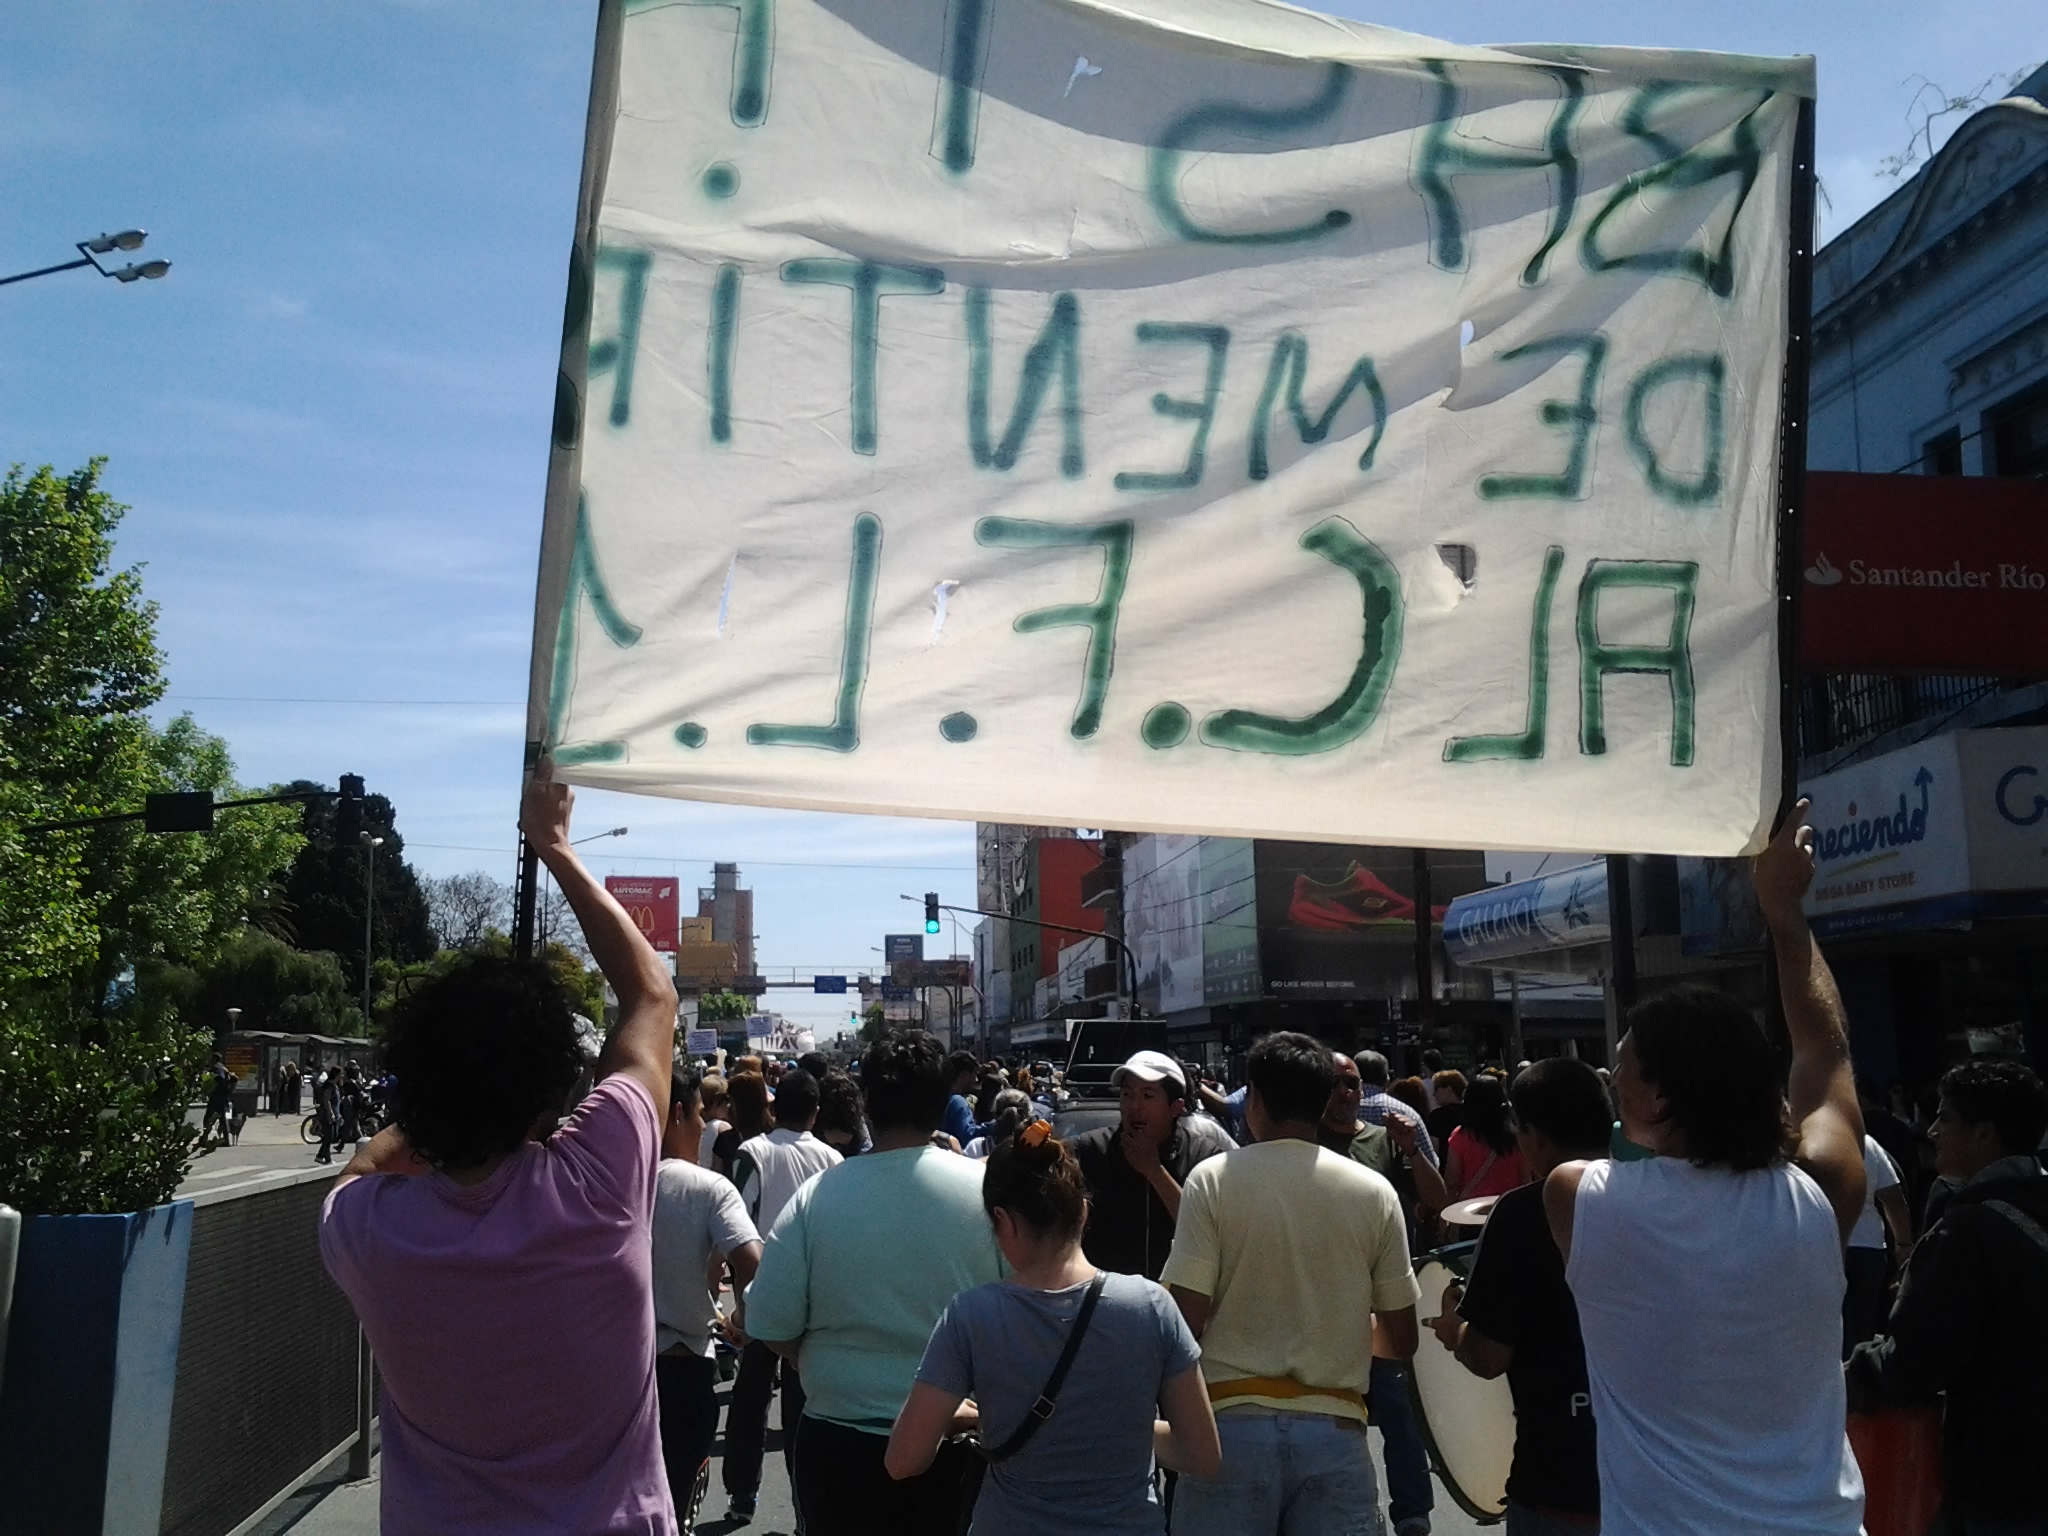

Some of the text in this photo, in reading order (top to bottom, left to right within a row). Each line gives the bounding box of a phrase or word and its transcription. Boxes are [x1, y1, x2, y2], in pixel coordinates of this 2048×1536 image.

[1849, 559, 2046, 590] Santander Río
[1803, 770, 1932, 861] reciendo
[1846, 879, 1874, 897] BABY
[1878, 871, 1916, 890] STORE
[1459, 897, 1531, 946] GALENO
[1270, 979, 1283, 989] GO
